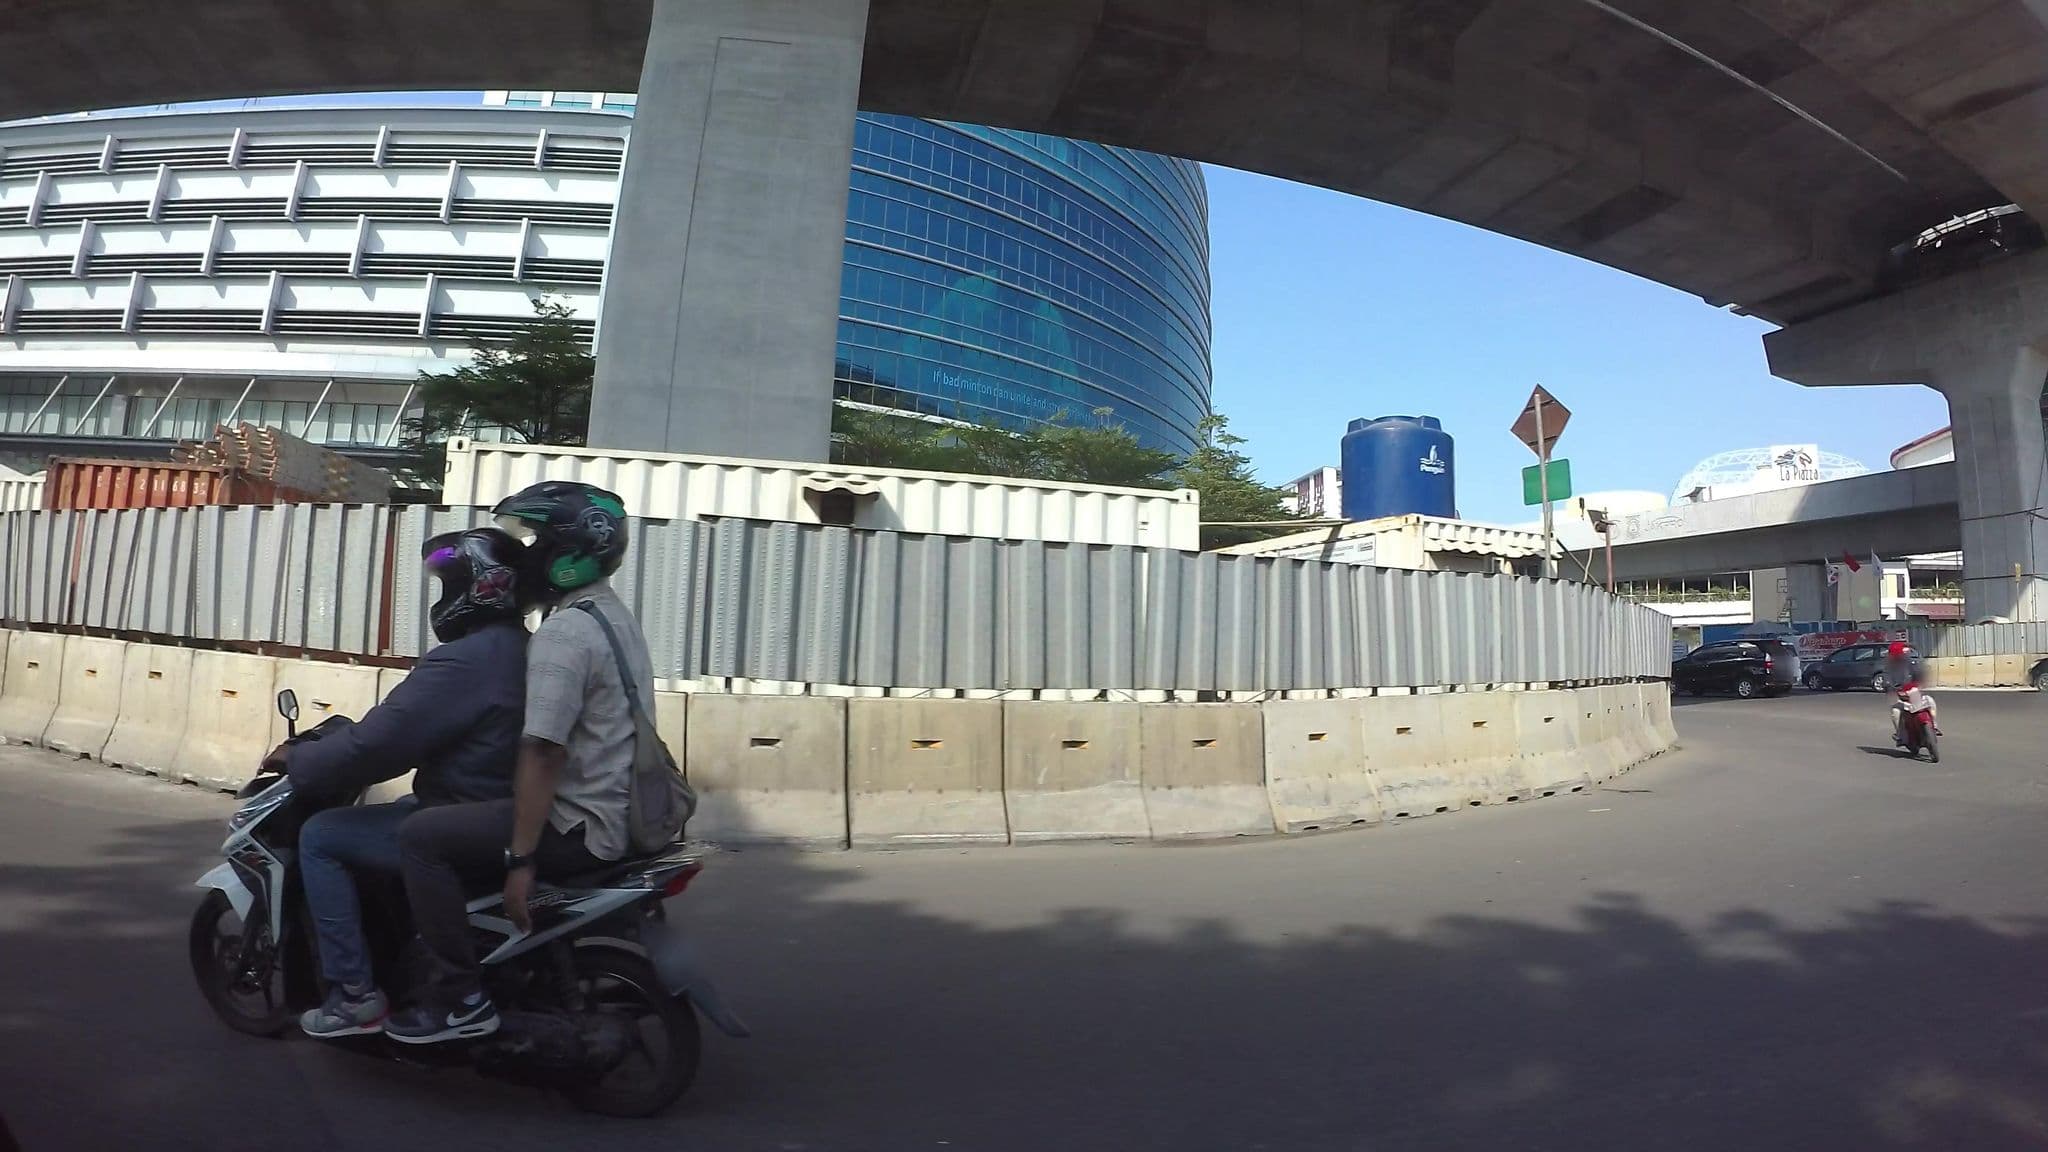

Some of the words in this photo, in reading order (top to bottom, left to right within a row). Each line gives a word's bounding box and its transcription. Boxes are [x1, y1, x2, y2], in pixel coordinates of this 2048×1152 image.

[933, 370, 942, 383] If
[943, 373, 992, 395] badminton
[1010, 391, 1031, 407] unite
[1780, 465, 1790, 481] La
[1793, 465, 1818, 481] Piazza
